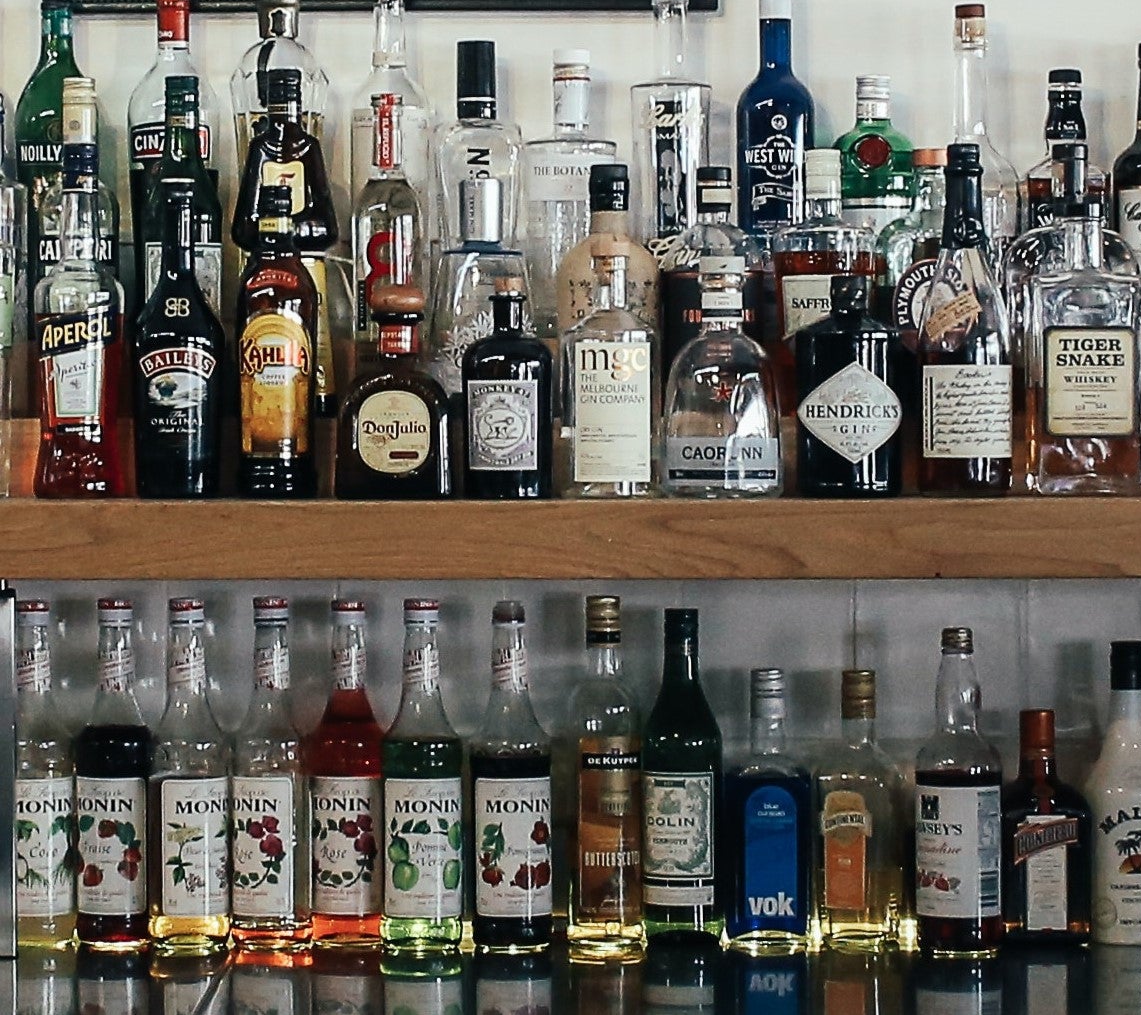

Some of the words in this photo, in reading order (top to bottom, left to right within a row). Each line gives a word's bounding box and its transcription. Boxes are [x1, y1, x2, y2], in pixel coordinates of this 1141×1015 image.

[20, 144, 62, 162] NOILLY
[744, 149, 774, 164] WEST
[554, 166, 591, 175] BOTAN
[792, 298, 830, 309] SAFFR
[42, 316, 111, 351] APEROL
[1059, 339, 1121, 351] TIGER
[144, 350, 213, 371] BAILEYS
[240, 337, 309, 374] KAHLA
[1056, 354, 1125, 366] SNAKE
[581, 348, 647, 381] mgc
[580, 373, 597, 382] THE
[1063, 375, 1117, 383] WHISKEY
[580, 384, 638, 394] MELBOURNE
[805, 404, 899, 418] HENDRICK'S
[682, 446, 763, 460] CAORNN
[748, 891, 795, 917] vok
